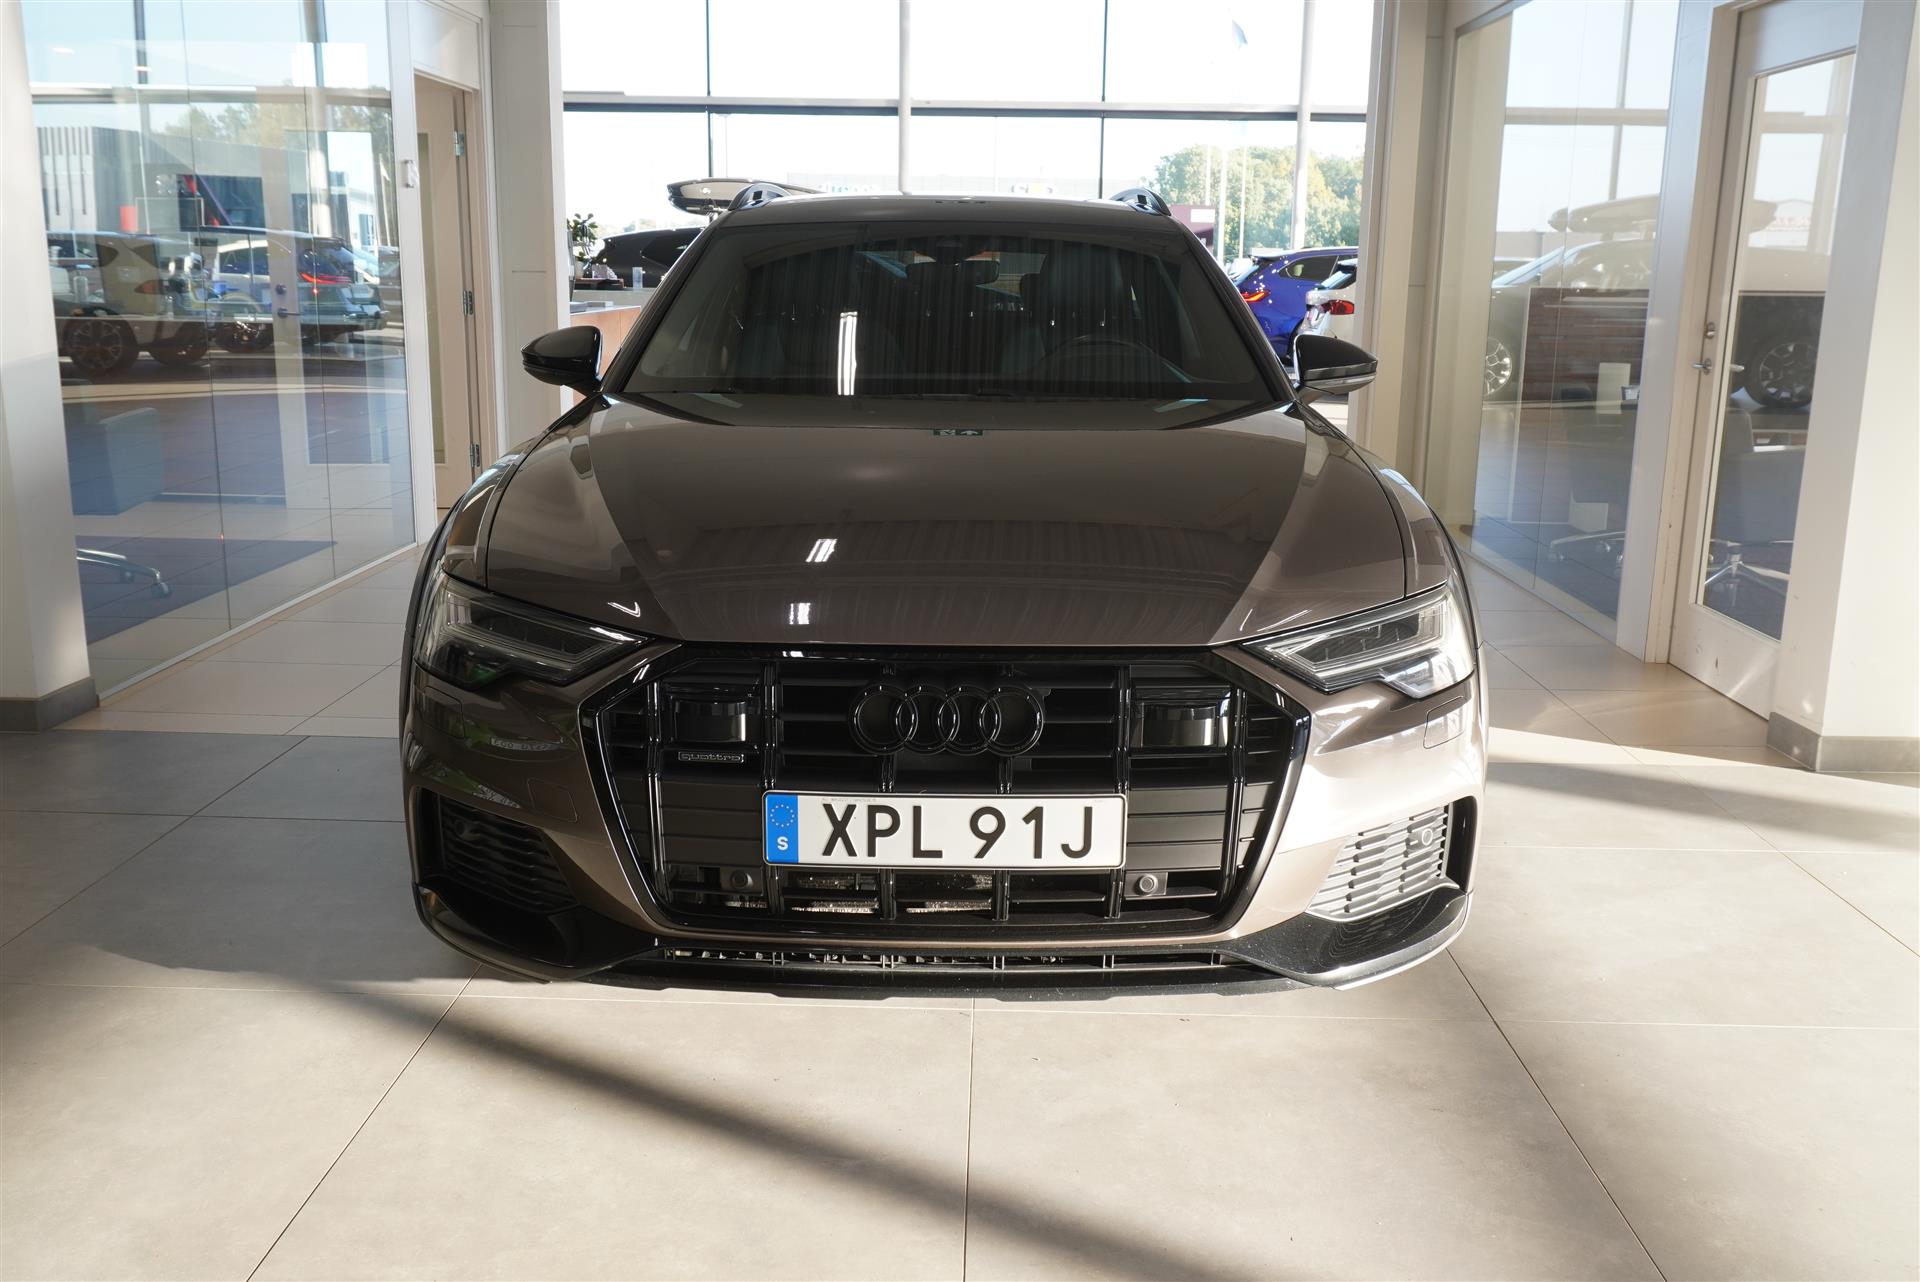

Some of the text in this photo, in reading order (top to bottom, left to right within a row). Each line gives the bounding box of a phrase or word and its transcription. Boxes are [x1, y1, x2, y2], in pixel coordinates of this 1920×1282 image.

[679, 752, 743, 762] quattro
[823, 804, 1092, 859] XPL 91J
[777, 837, 789, 851] S
